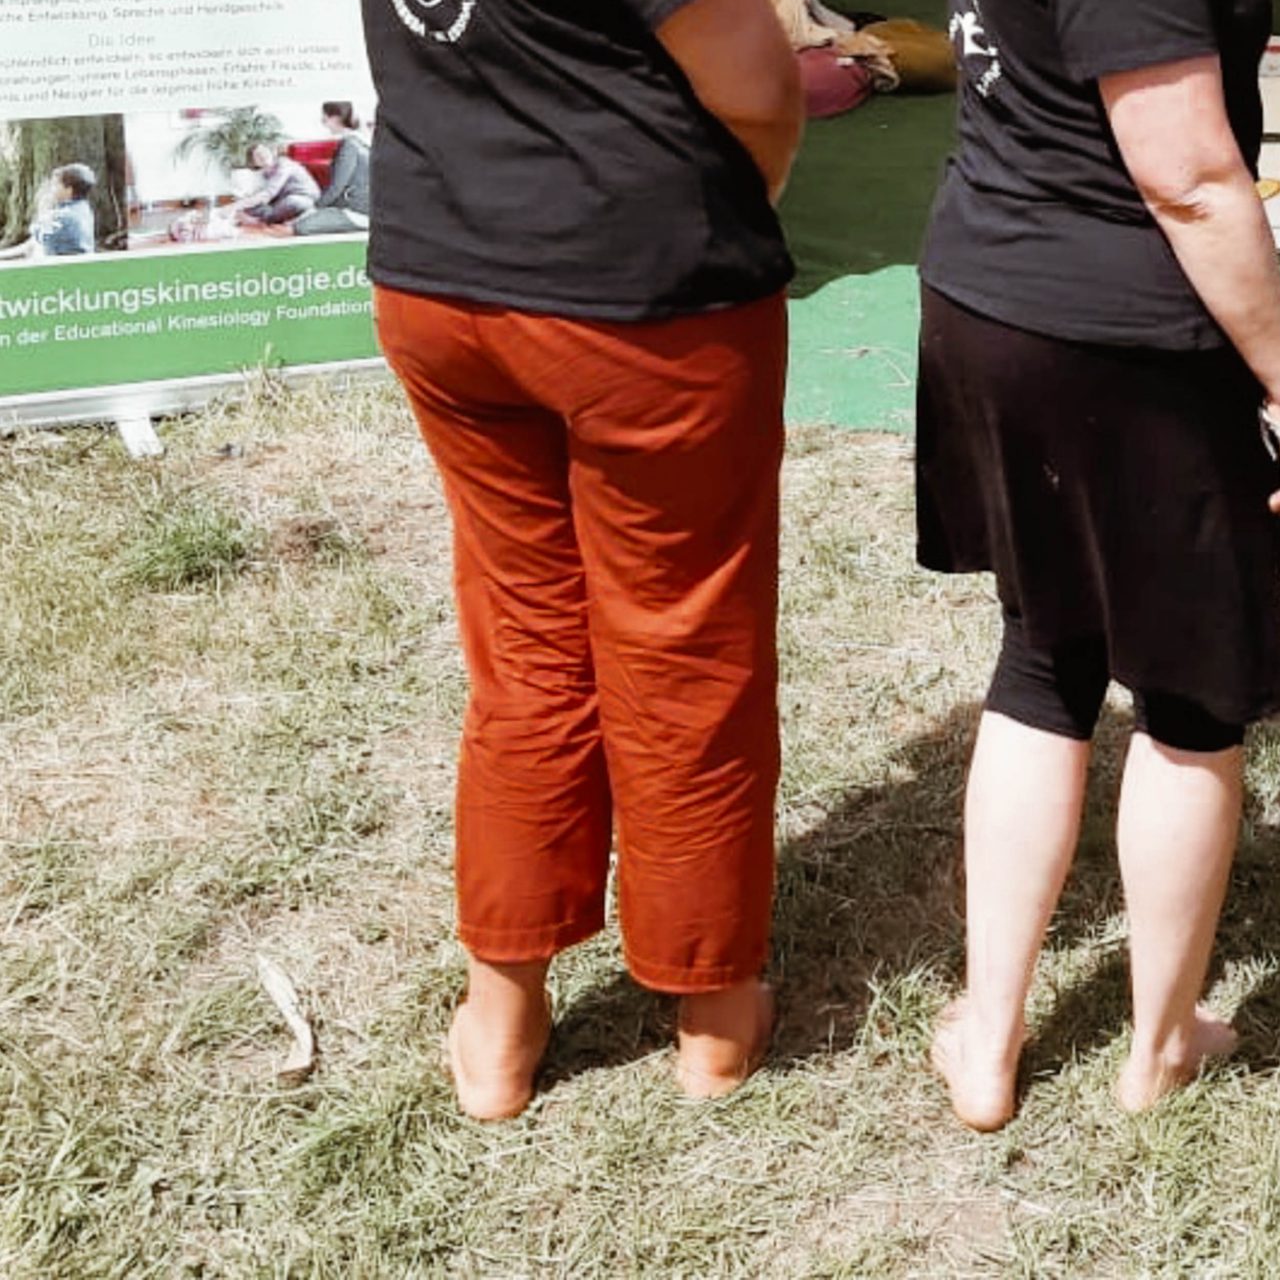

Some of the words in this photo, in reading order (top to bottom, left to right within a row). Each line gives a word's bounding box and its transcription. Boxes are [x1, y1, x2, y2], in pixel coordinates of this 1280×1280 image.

[16, 328, 48, 345] der
[55, 318, 163, 342] Educational
[168, 310, 270, 331] Kinesiology
[277, 298, 374, 321] Foundation
